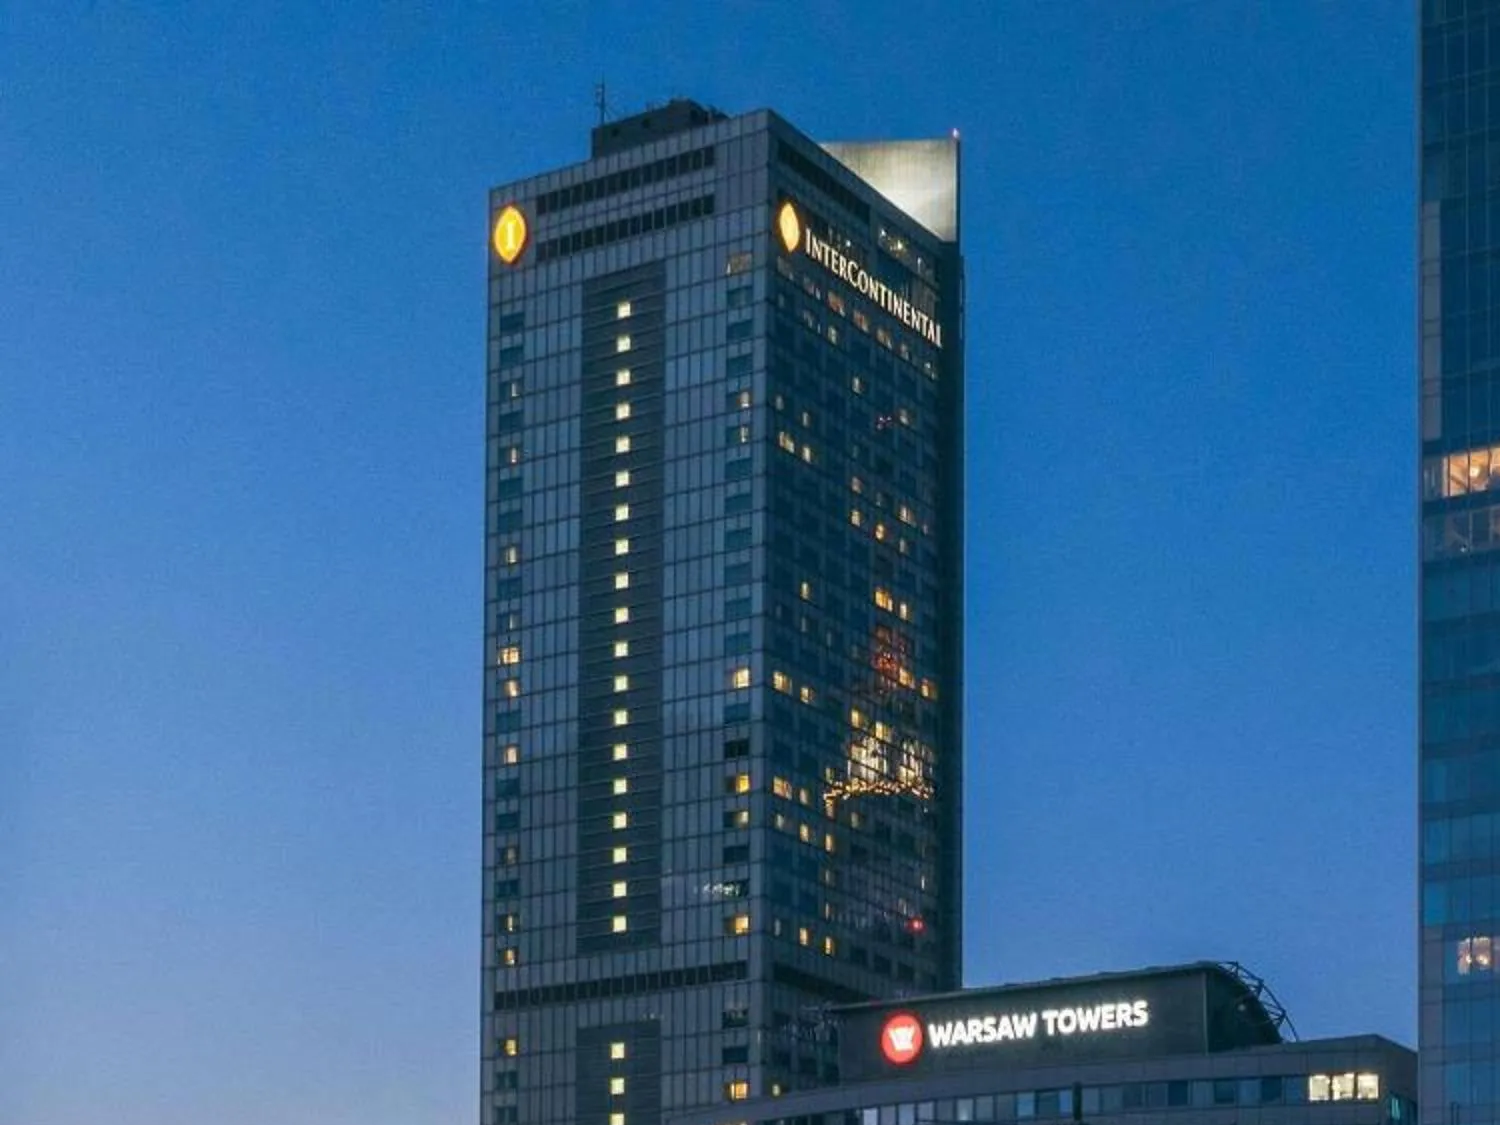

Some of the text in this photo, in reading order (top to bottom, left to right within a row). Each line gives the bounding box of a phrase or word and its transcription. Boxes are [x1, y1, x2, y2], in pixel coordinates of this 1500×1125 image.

[805, 227, 942, 348] INTERCONTINENTAL
[927, 999, 1150, 1048] WARSAW TOWERS
